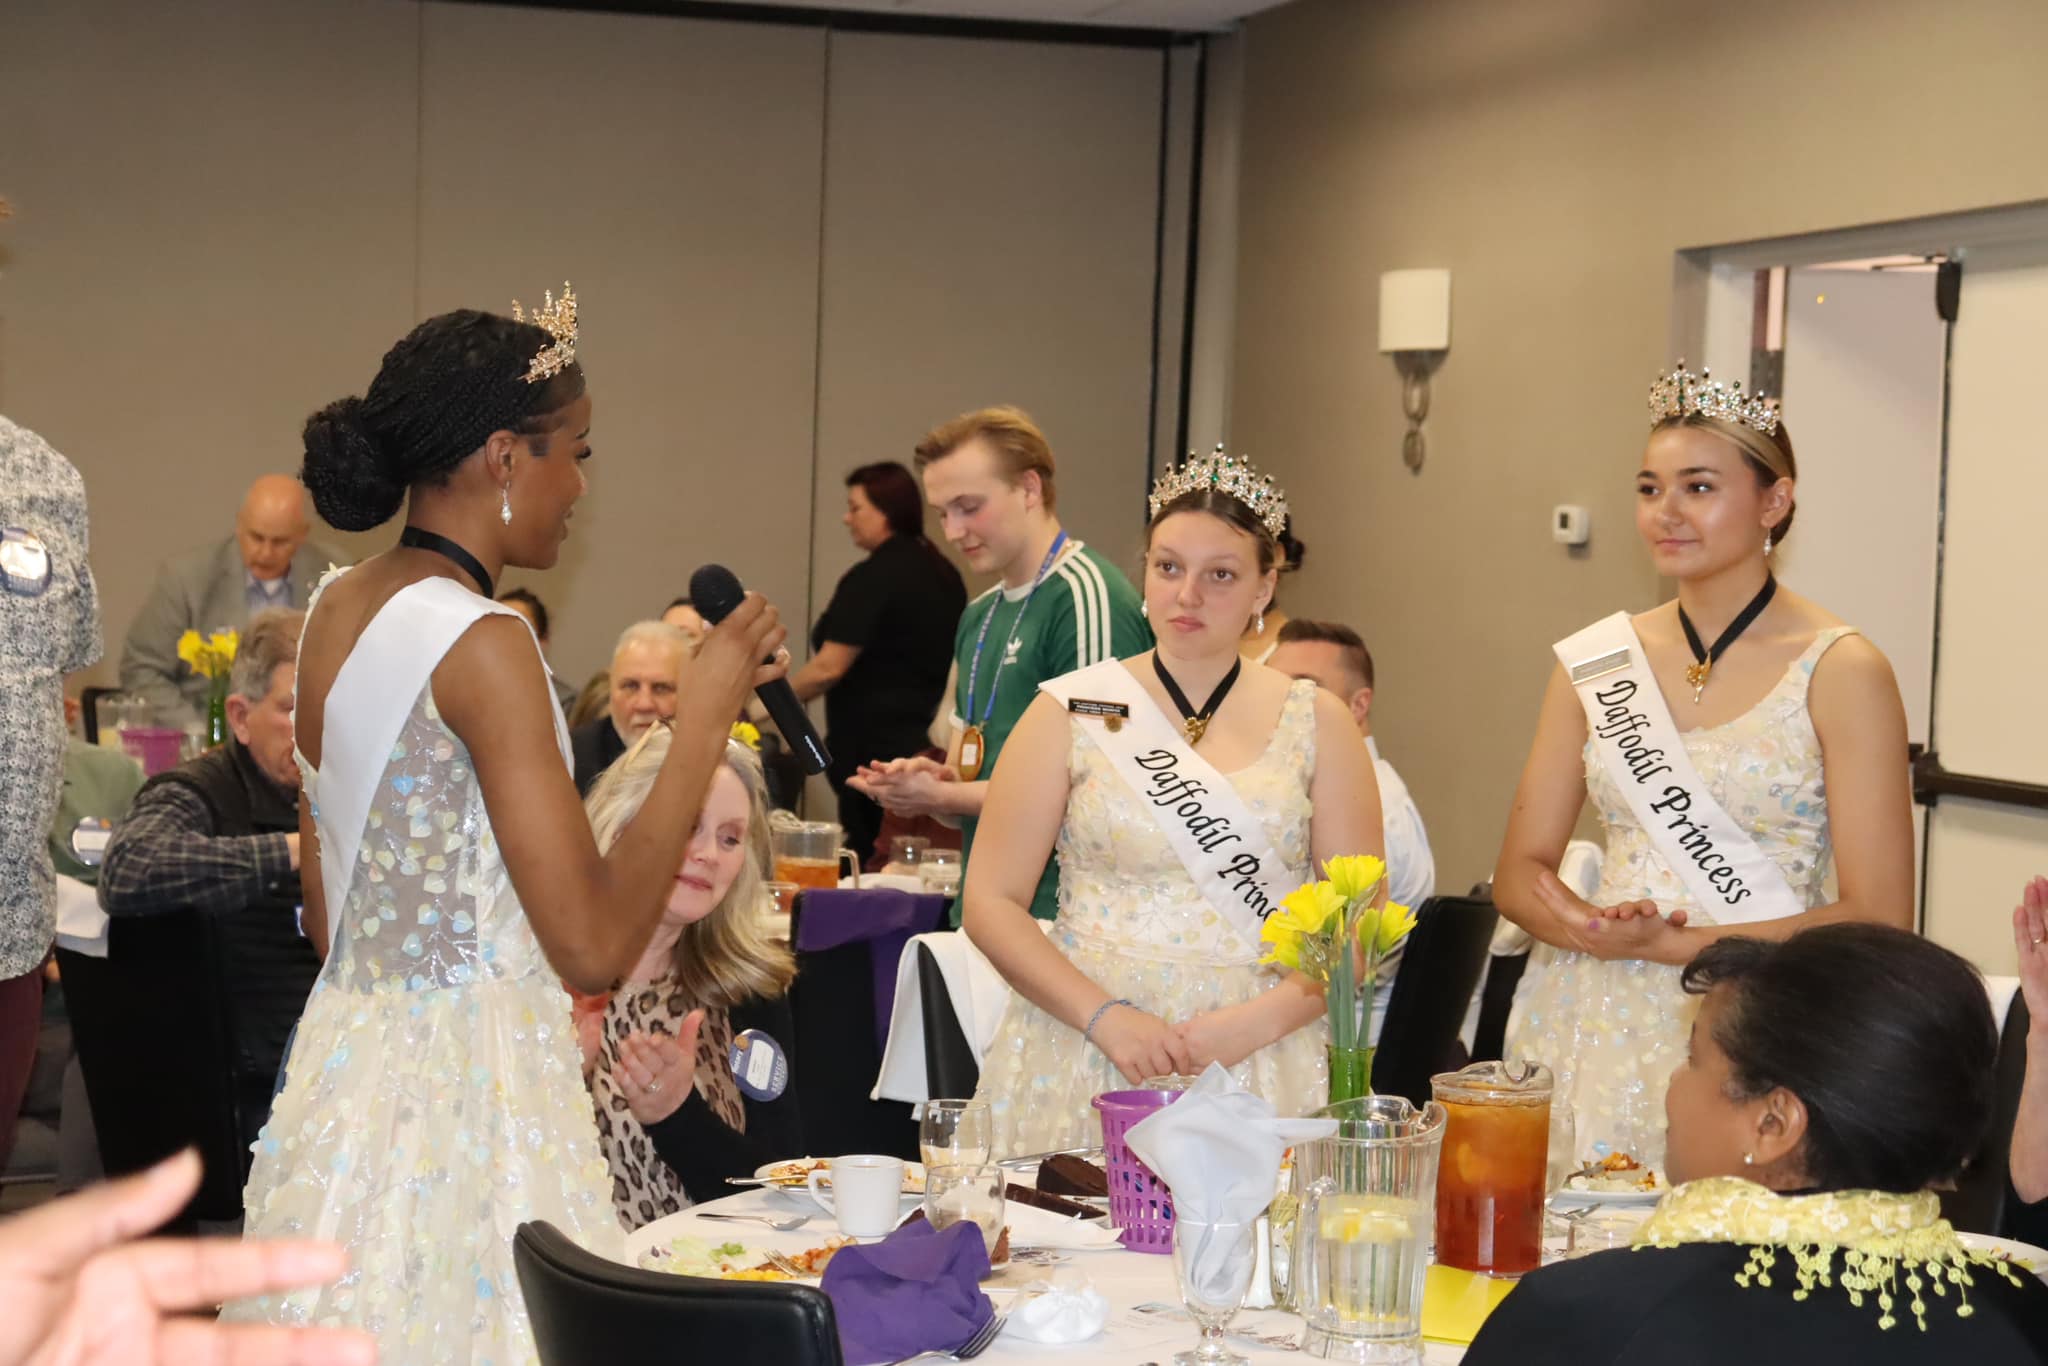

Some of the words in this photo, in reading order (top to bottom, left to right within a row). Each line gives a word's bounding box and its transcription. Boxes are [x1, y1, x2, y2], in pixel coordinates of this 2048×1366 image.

[1134, 749, 1242, 854] Daffodil
[1595, 679, 1673, 785] Daffodil
[1650, 785, 1752, 905] Princess
